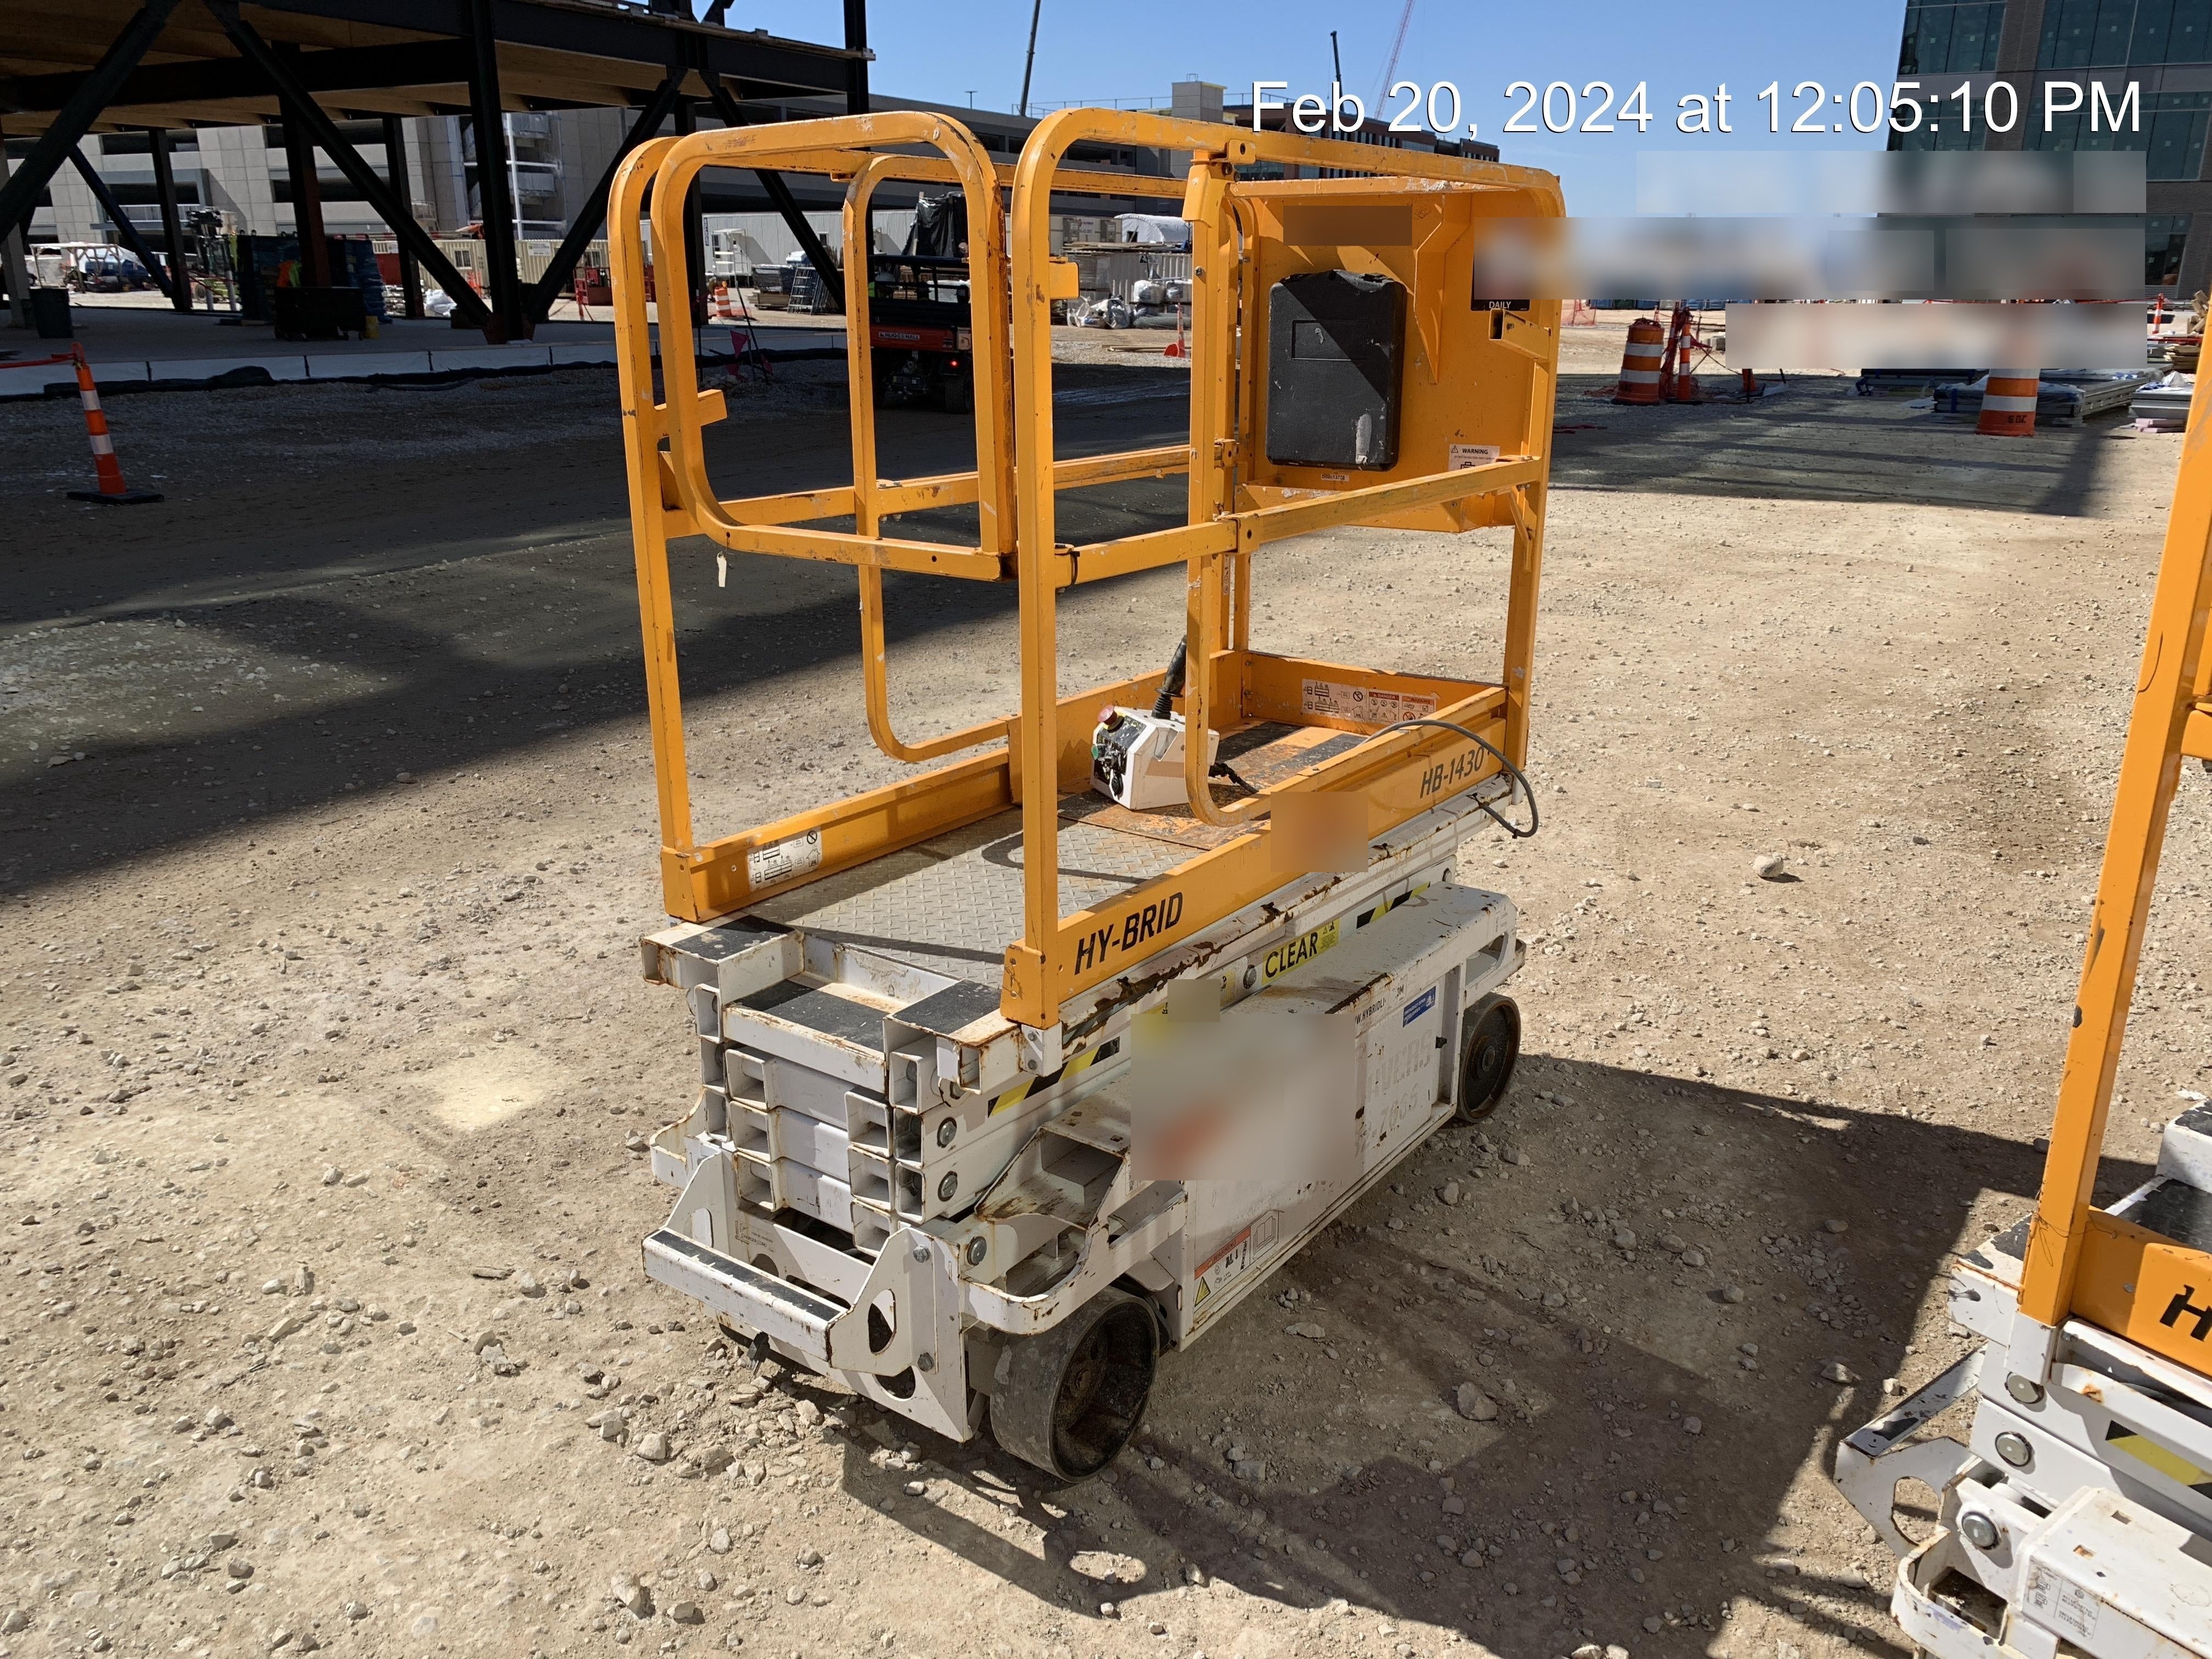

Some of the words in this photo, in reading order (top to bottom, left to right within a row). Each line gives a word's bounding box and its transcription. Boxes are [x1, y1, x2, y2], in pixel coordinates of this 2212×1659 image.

[1488, 301, 1511, 309] DAILY
[1420, 746, 1485, 799] HB-1430
[1074, 891, 1183, 975] HY-BRID
[1265, 932, 1318, 978] CLEAR
